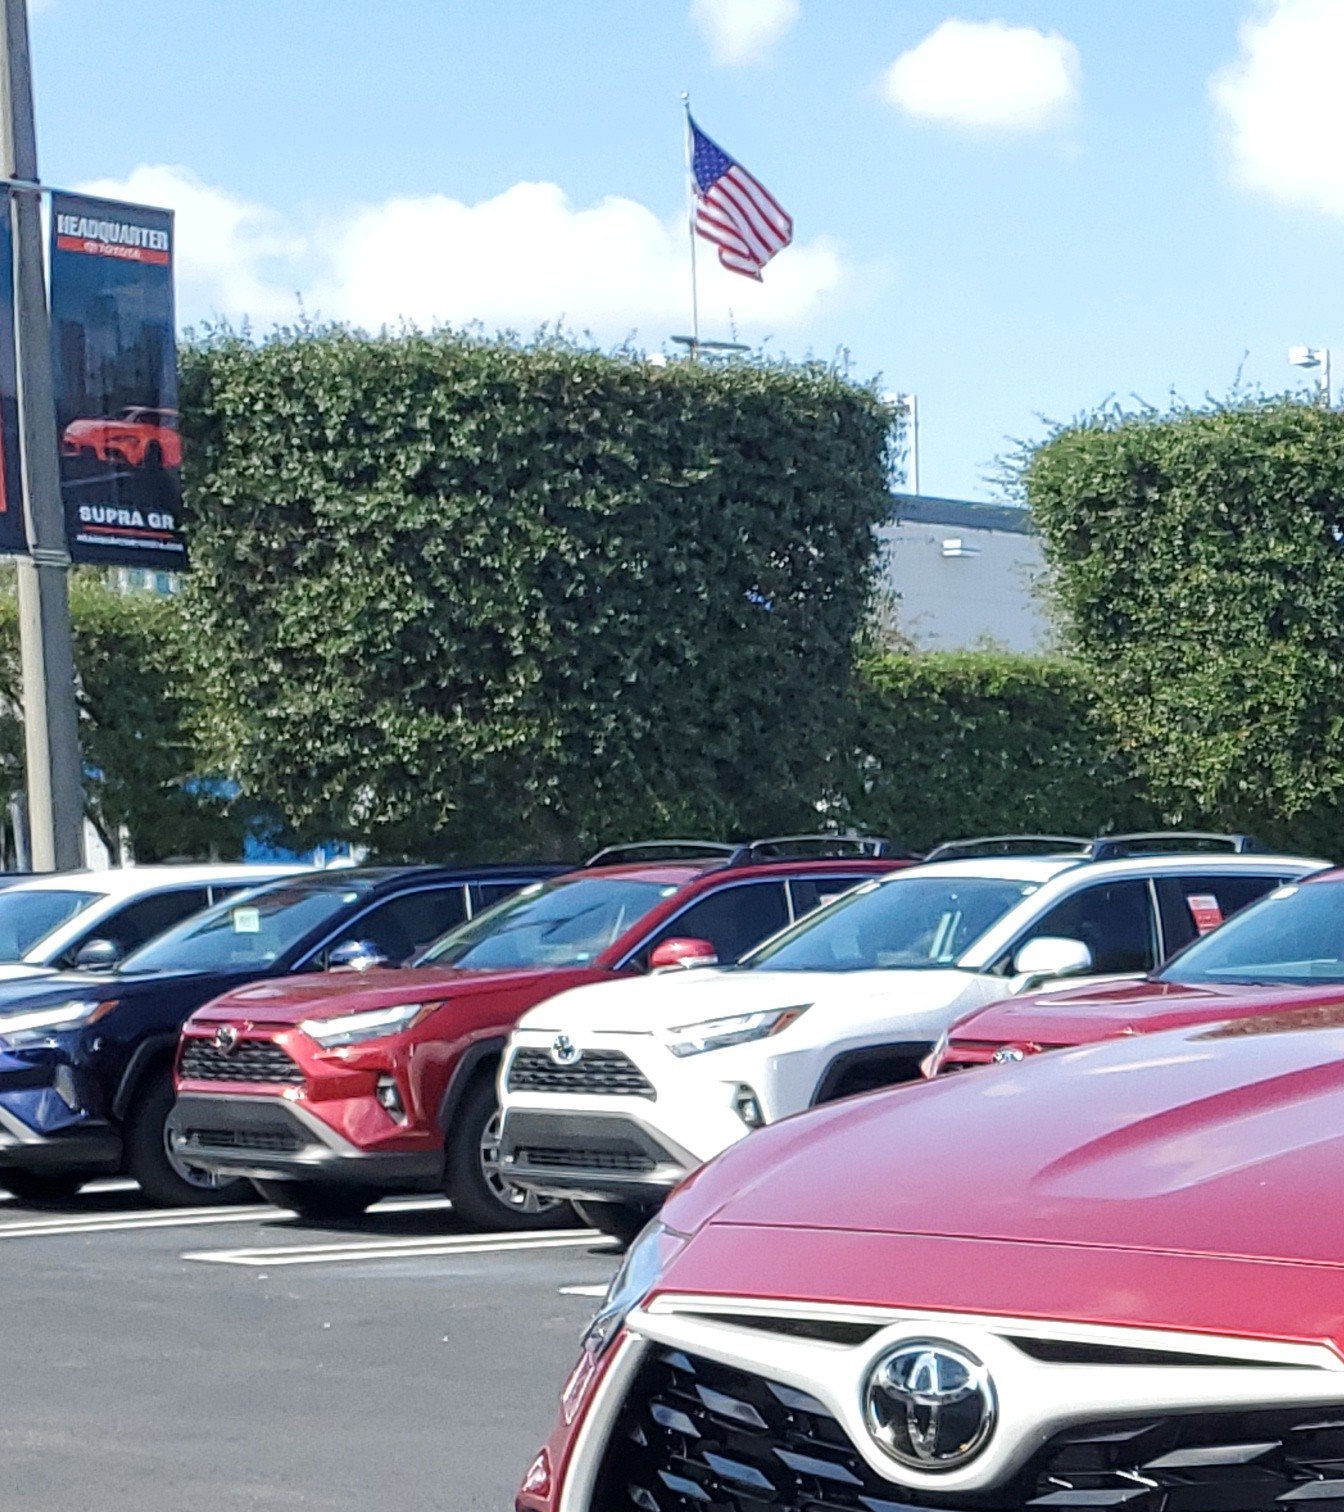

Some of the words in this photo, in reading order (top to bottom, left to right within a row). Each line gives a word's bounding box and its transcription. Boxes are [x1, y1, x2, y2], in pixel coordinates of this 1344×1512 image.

[57, 214, 169, 251] HEADQUARTER
[79, 505, 146, 528] SUPRA
[147, 512, 176, 531] GR
